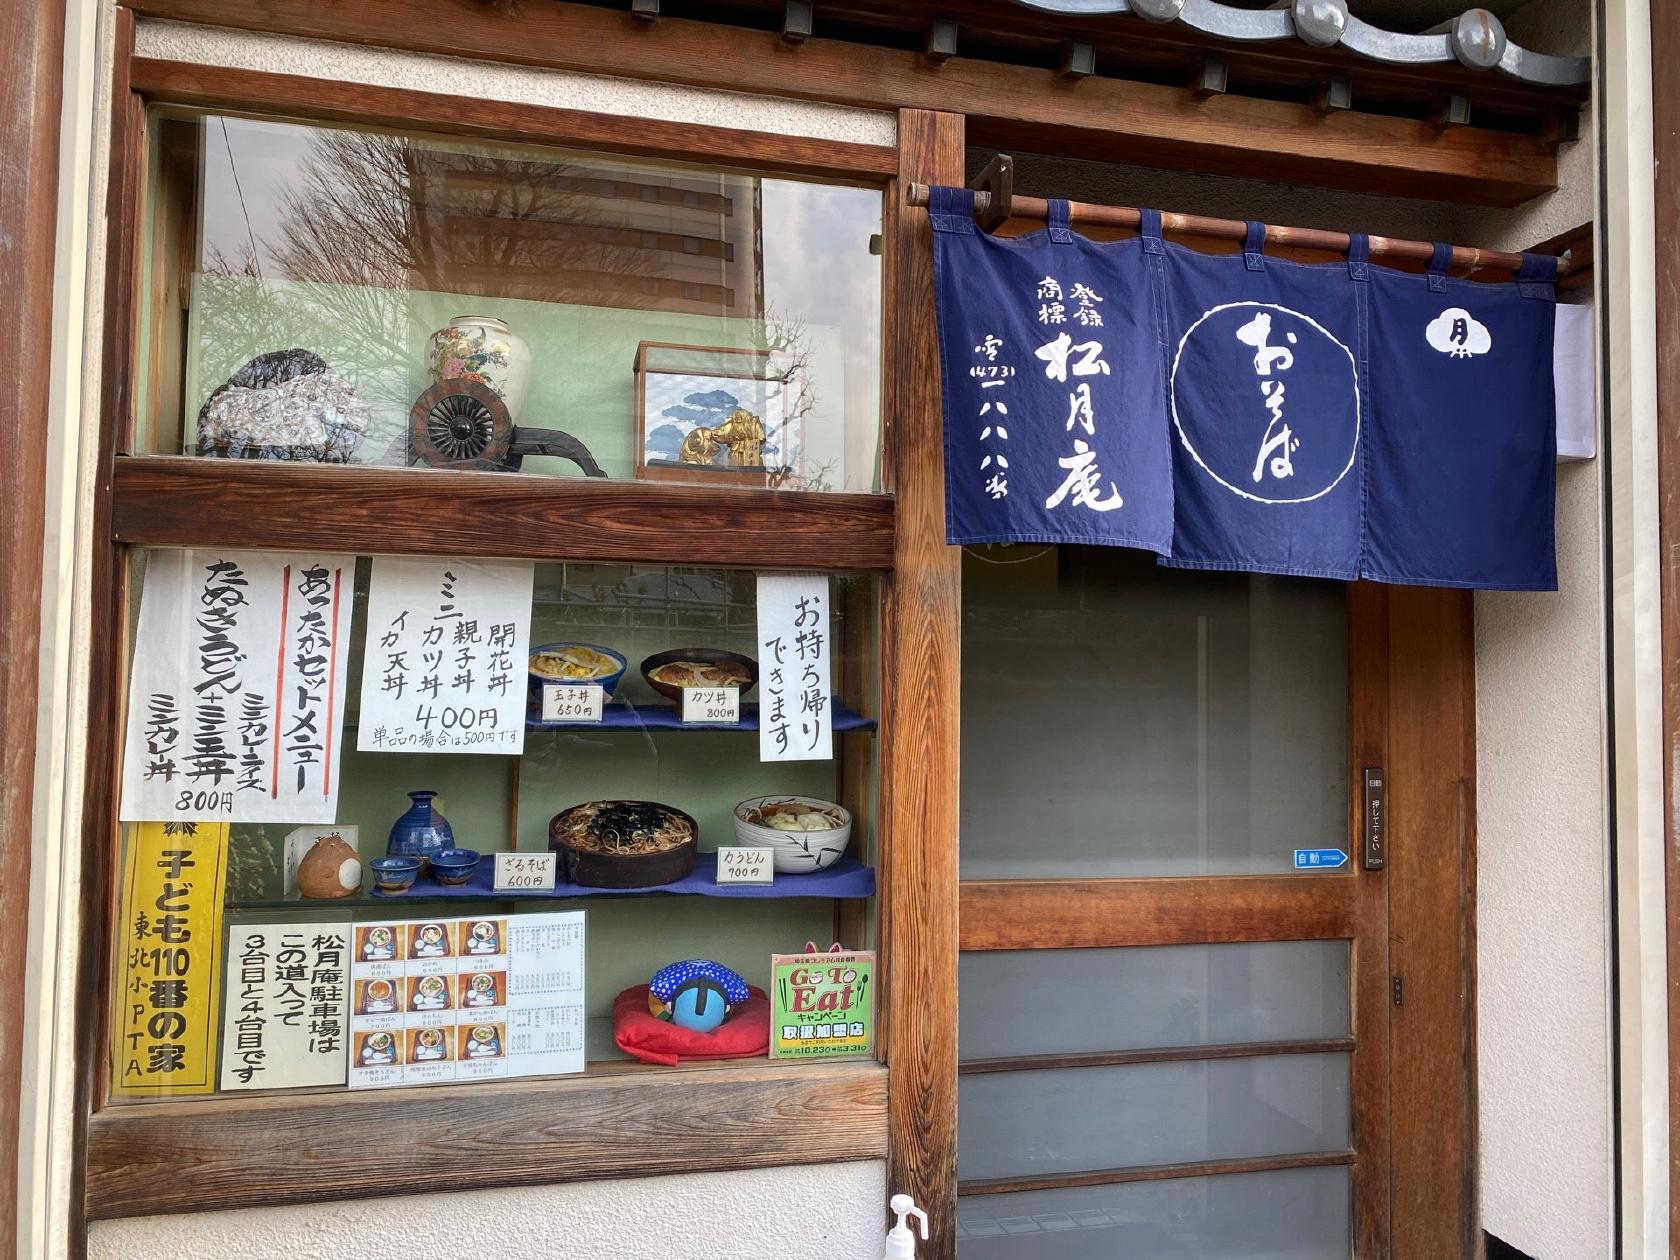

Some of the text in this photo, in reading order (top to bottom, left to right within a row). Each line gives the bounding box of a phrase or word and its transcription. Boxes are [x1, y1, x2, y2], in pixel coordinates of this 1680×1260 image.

[1036, 276, 1067, 325] 商標
[1069, 283, 1104, 327] 登録
[1236, 311, 1300, 483] おそば
[1034, 332, 1124, 512] 松月庵
[434, 571, 464, 620] ミニ
[283, 563, 332, 796] あったかセットメニュー
[381, 610, 411, 701] イカ天丼
[416, 625, 444, 700] カツ丼
[452, 619, 483, 694] 親子丼
[487, 622, 516, 697] 開花丼
[794, 595, 828, 752] お持ち帰り
[416, 704, 498, 730] 400円
[554, 689, 590, 702] 玉子丼
[557, 704, 592, 716] 650円
[691, 690, 728, 705] カツ丼
[706, 708, 735, 718] 800円
[765, 636, 792, 755] できます
[372, 725, 519, 749] 単品の場合は500円です
[175, 790, 234, 814] 800円
[505, 858, 550, 872] ざるそば
[508, 875, 543, 886] 600円
[728, 867, 760, 878] 700円
[1298, 852, 1320, 865] 自動
[146, 850, 196, 1073] 子ども110番の家
[273, 934, 309, 1027] この道入って
[790, 968, 824, 986] Go
[125, 911, 153, 1077] 東北小PTA
[231, 934, 270, 1084] 3台目と4台目です
[308, 934, 346, 1054] 松月庵駐車場は
[789, 984, 854, 1012] Eat
[797, 1012, 846, 1022] キャンペーン
